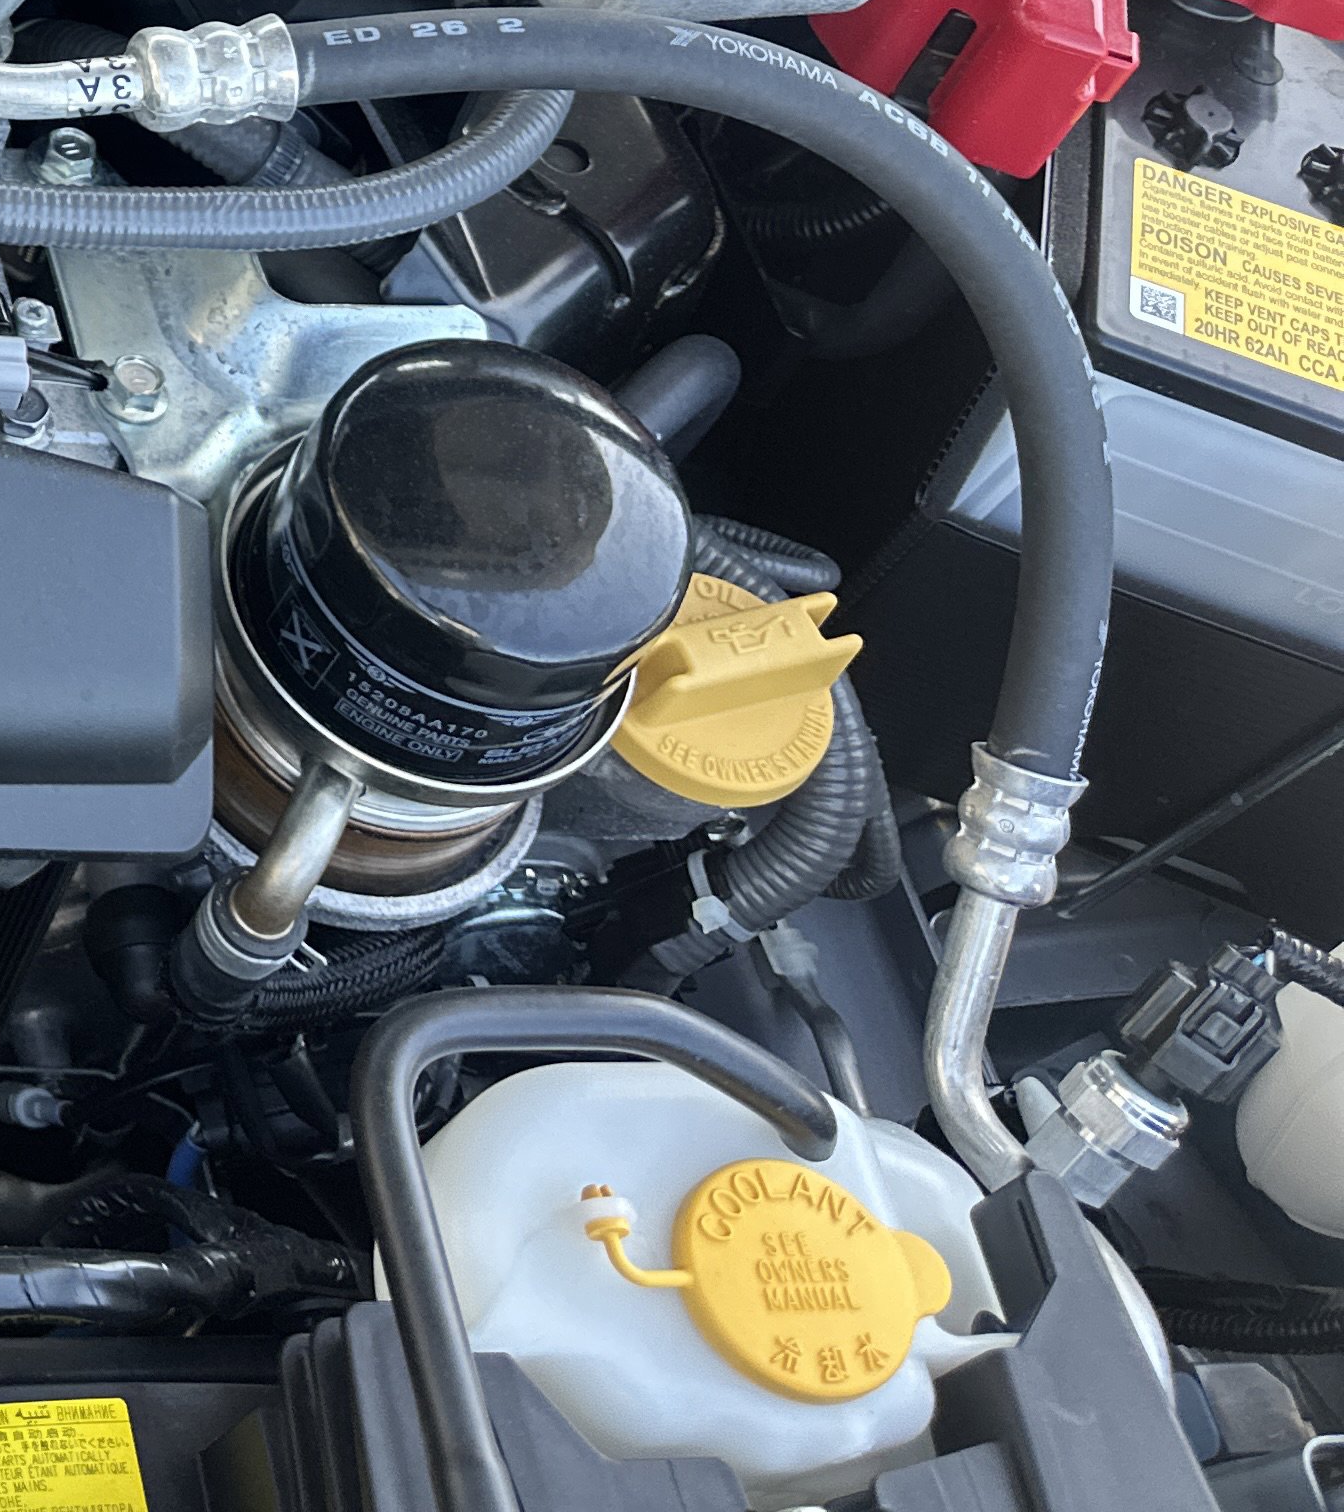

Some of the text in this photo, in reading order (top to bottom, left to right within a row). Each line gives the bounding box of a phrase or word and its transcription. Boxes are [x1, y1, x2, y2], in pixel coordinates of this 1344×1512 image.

[322, 26, 381, 46] ED
[410, 19, 468, 39] 26
[497, 17, 526, 34] 2
[703, 32, 839, 90] YOKOHAMA
[1142, 191, 1178, 210] Always
[1180, 205, 1211, 222] shield
[1213, 217, 1237, 232] eyes
[1240, 227, 1260, 239] and
[1286, 241, 1310, 256] from
[1143, 164, 1233, 209] DANGER
[1241, 200, 1321, 239] EXPLOSIVE
[1236, 214, 1247, 223] or
[1249, 219, 1283, 237] sparks
[1285, 232, 1313, 247] could
[1140, 222, 1228, 267] POISON
[1242, 259, 1302, 291] CAUSES
[1196, 232, 1216, 245] and
[1203, 224, 1237, 242] cables
[1239, 237, 1250, 246] or
[1139, 237, 1185, 262] Contains
[1253, 278, 1282, 296] Avoid
[1285, 290, 1324, 310] contact
[1151, 255, 1180, 271] event
[1182, 266, 1193, 276] of
[1195, 270, 1239, 292] accident
[1269, 296, 1290, 309] with
[1204, 286, 1244, 310] KEEP
[1247, 302, 1287, 326] VENT
[1290, 318, 1330, 342] CAPS
[1204, 302, 1244, 326] KEEP
[1247, 318, 1278, 339] OUT
[1282, 330, 1302, 347] OF
[1194, 317, 1339, 383] 20HR 62Ah CCA
[694, 576, 745, 611] OIL
[338, 701, 403, 744] ENGINE
[407, 740, 457, 761] ONLY
[345, 687, 471, 749] GENUINE PARTS
[346, 670, 488, 739] 15208AA170
[659, 734, 700, 770] SEE
[783, 703, 829, 769] MANUAL
[696, 1168, 876, 1242] COOLANT
[755, 1257, 850, 1284] OWNERS
[761, 1231, 813, 1257] SEE
[762, 1285, 862, 1311] MANUAL
[56, 1403, 118, 1422] ВНИМАНИЕ
